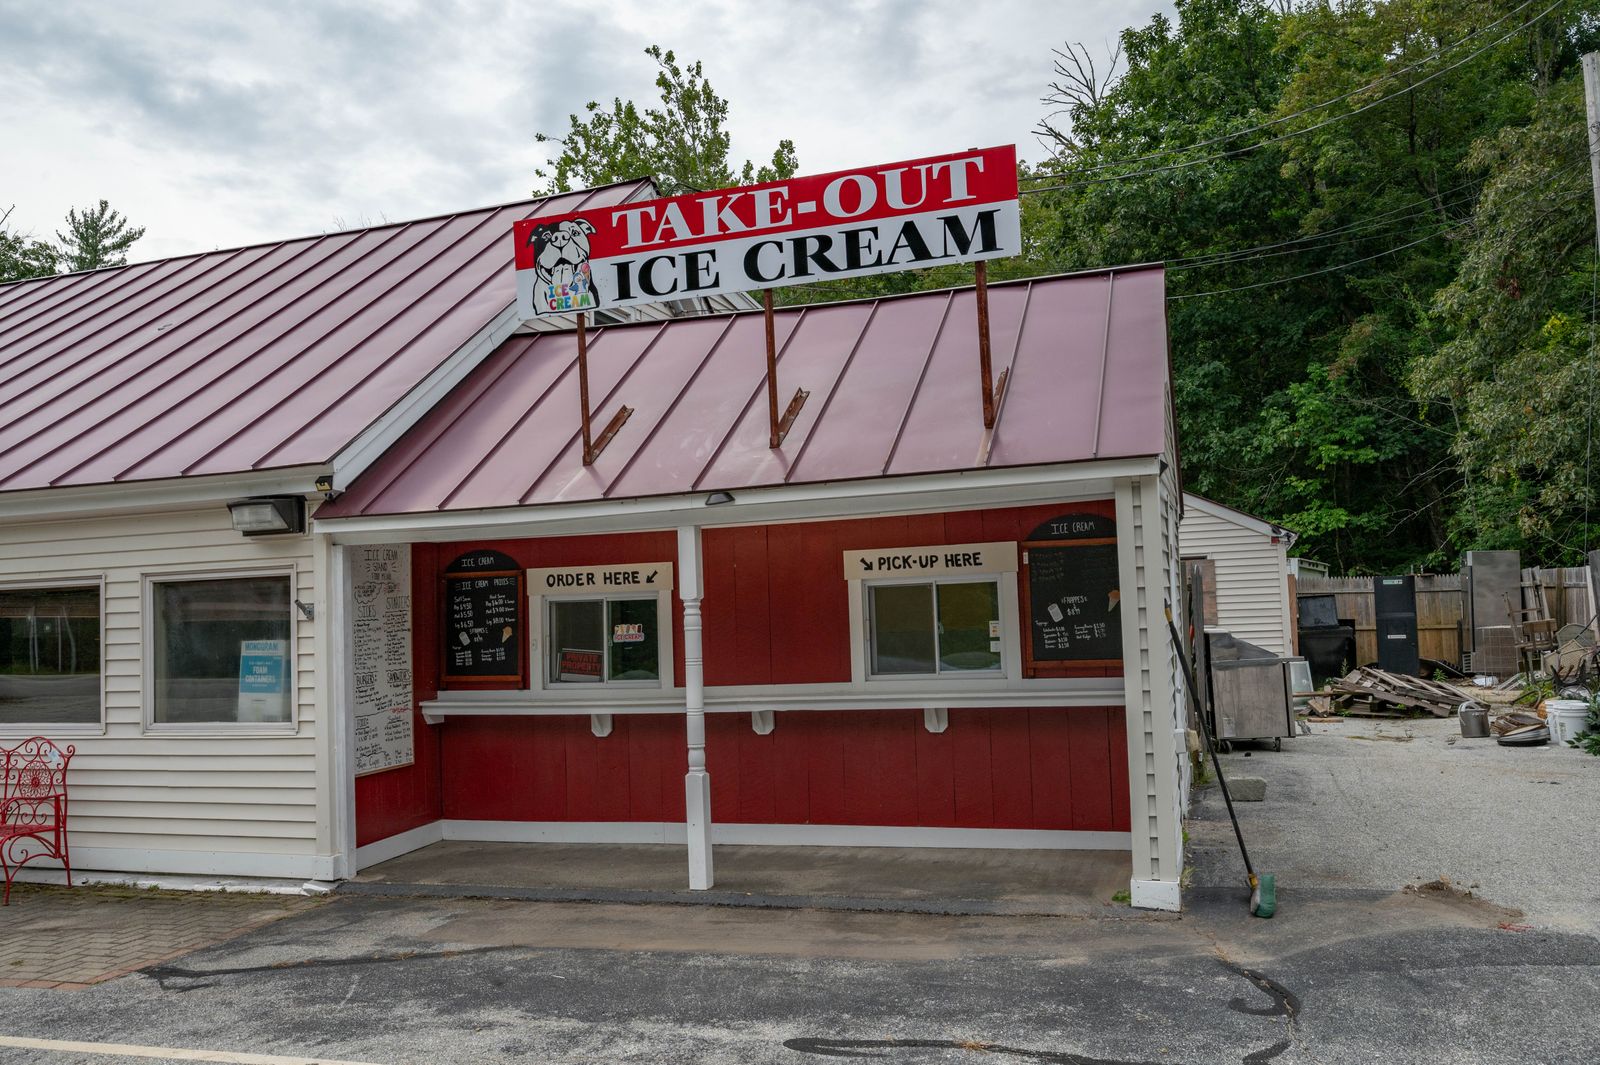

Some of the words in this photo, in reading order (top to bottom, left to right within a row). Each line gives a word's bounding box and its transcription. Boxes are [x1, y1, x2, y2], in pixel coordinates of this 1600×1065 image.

[612, 155, 984, 249] TAKE-OUT
[611, 249, 720, 302] ICE
[743, 209, 1005, 283] CREAM
[548, 284, 570, 298] ICE
[549, 293, 591, 310] CREAM
[1050, 522, 1069, 534] ICE
[1072, 521, 1096, 533] CREAM
[364, 548, 380, 561] ICE
[382, 548, 398, 561] CREAM
[461, 558, 476, 567] ICE
[478, 556, 494, 566] CREAM
[878, 554, 939, 571] PICK-UP
[944, 552, 983, 568] HERE
[462, 581, 472, 590] ICE
[546, 572, 596, 588] ORDER
[603, 571, 640, 585] HERE
